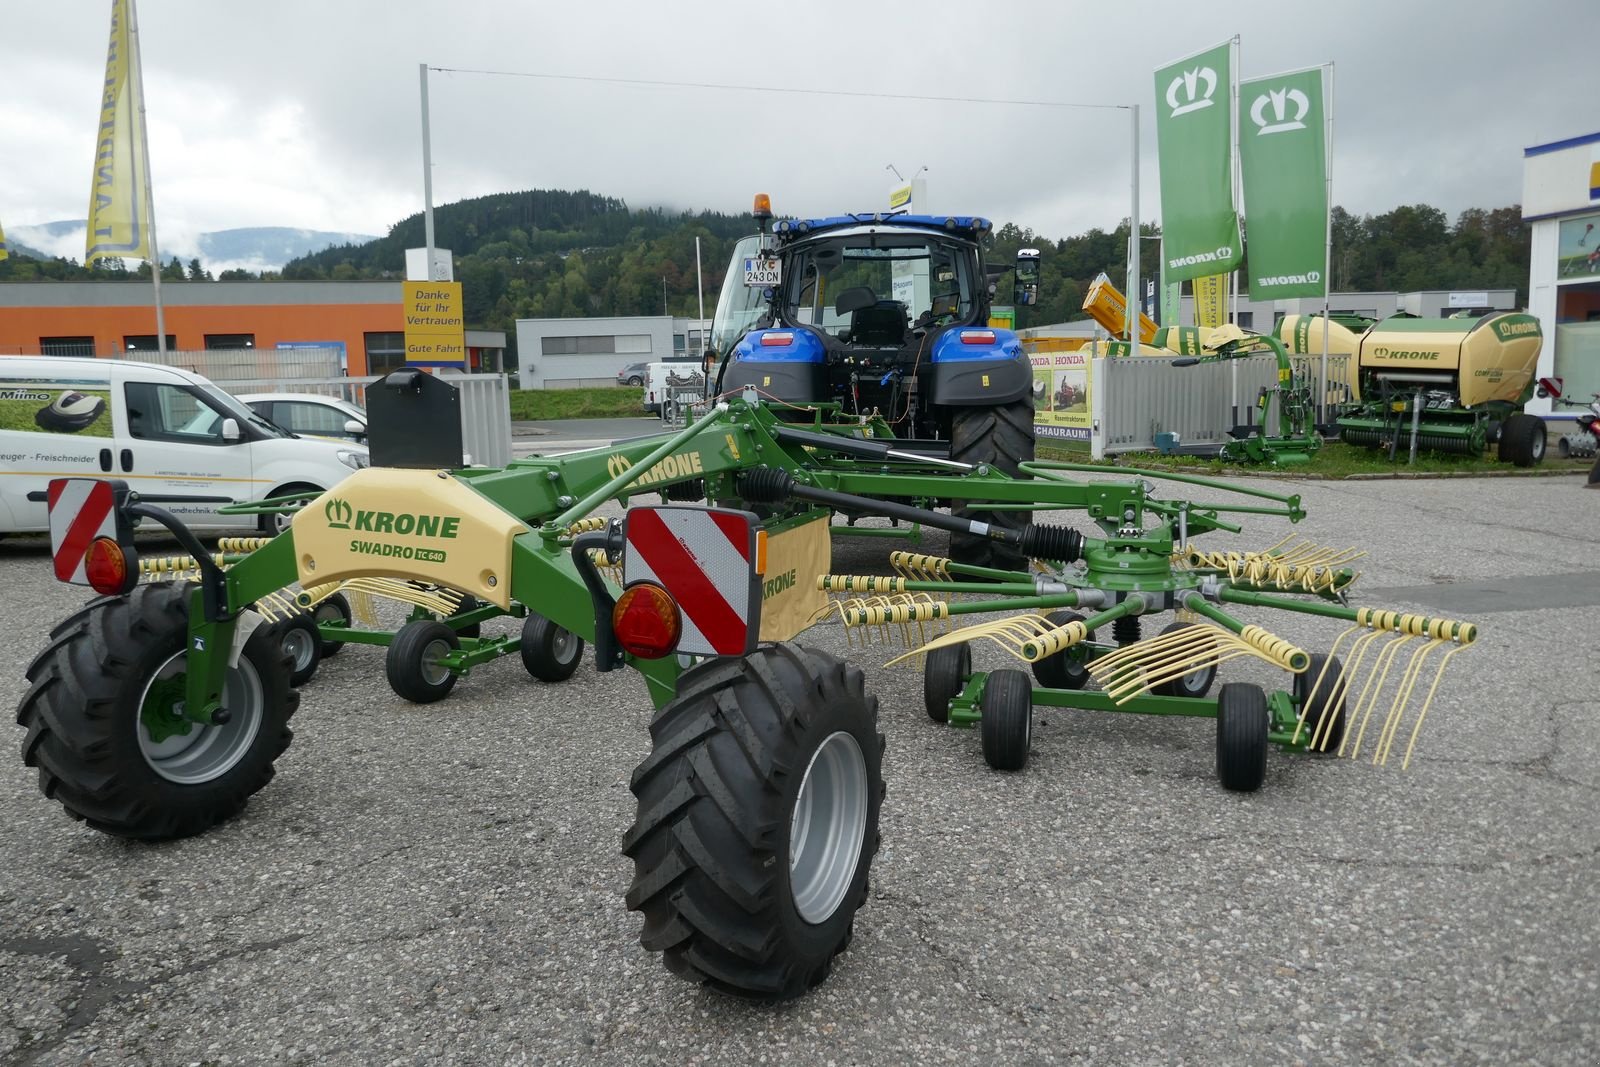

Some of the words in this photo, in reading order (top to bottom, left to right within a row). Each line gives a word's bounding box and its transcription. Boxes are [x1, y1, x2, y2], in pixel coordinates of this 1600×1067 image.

[756, 261, 767, 271] VK
[747, 271, 764, 281] 243
[766, 271, 778, 281] CN
[416, 290, 450, 300] Danke
[416, 303, 431, 313] für
[436, 303, 450, 313] Ihr
[408, 315, 461, 326] Vertrauen
[408, 344, 432, 353] Gute
[436, 345, 461, 353] Fahrt
[1055, 355, 1085, 365] HONDA
[1389, 351, 1440, 361] KRONE
[1031, 358, 1050, 366] ONDA
[0, 390, 50, 400] Miimo
[1034, 426, 1089, 438] CHAURAUM!
[0, 454, 26, 462] euger
[36, 453, 95, 463] Freischneider
[168, 506, 218, 515] landtechnik.c
[355, 510, 461, 538] KRONE
[350, 540, 414, 559] SWADRO
[418, 551, 428, 559] TC
[429, 552, 443, 560] 640
